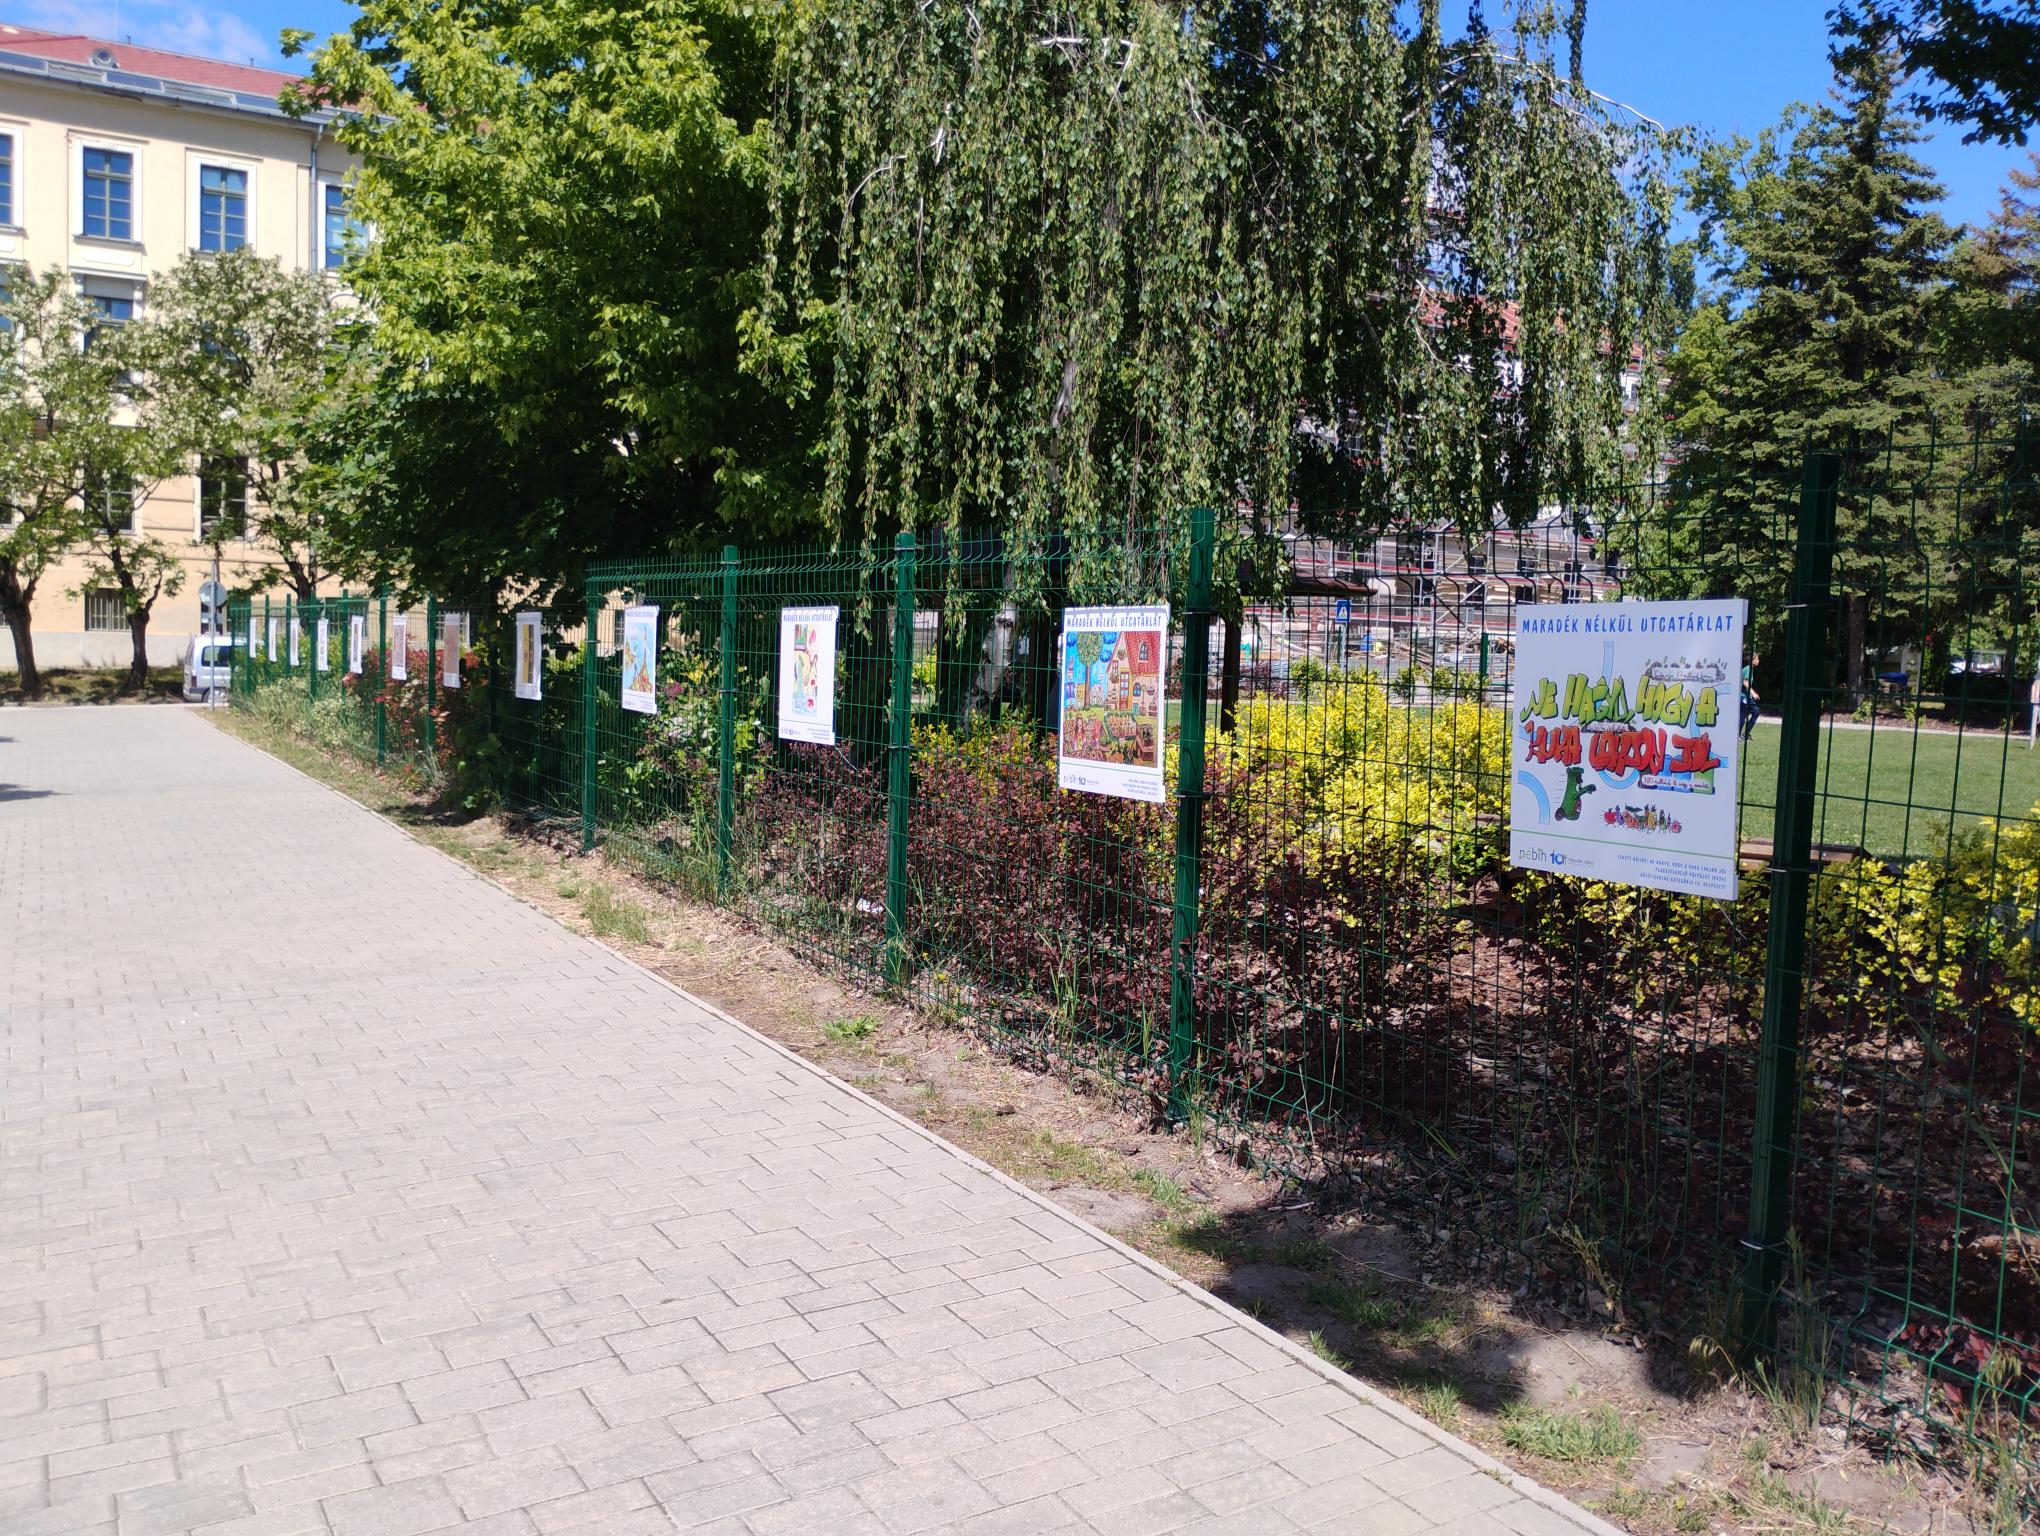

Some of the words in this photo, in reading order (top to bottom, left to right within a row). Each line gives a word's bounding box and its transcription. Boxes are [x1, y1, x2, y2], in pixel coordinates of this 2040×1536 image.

[1522, 615, 1578, 633] MARADÉK
[1585, 614, 1633, 633] NÉLKÜL
[1640, 612, 1733, 633] UTCATÁRLAT
